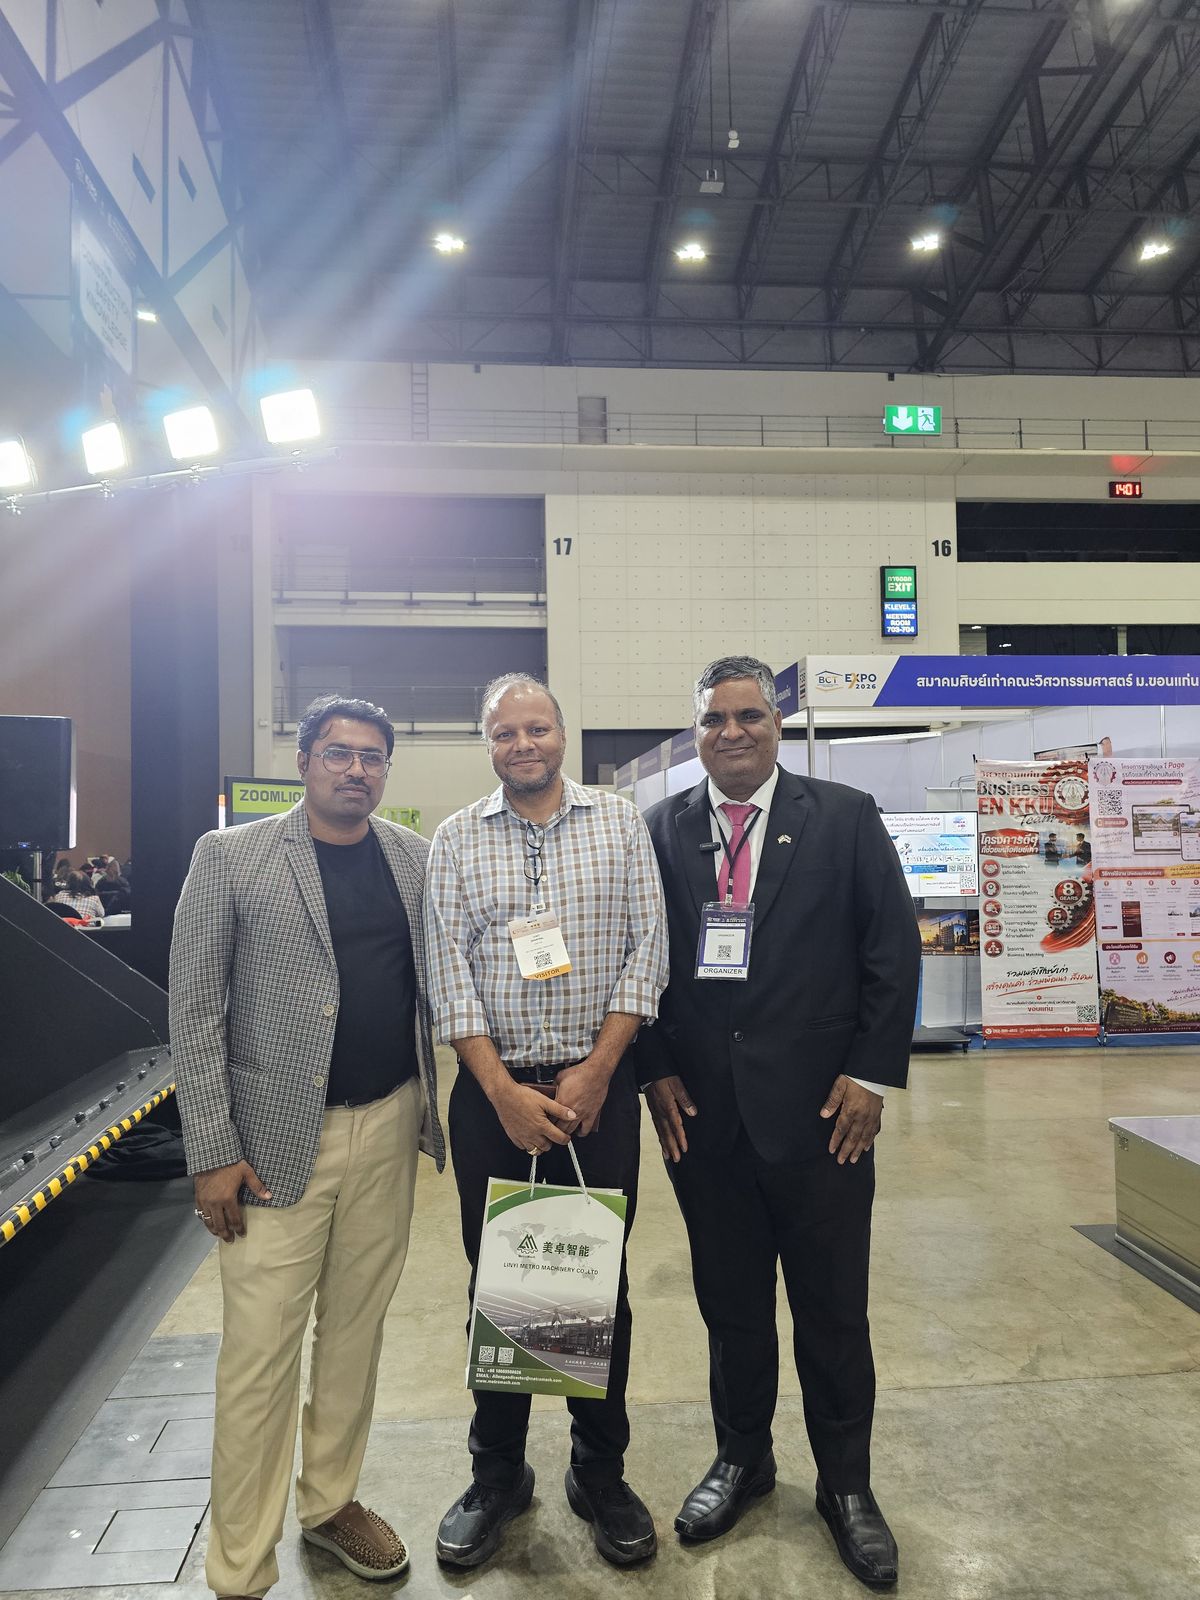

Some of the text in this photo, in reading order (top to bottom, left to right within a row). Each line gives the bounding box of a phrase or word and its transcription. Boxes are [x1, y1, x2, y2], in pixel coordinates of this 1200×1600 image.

[553, 537, 572, 555] 17
[932, 539, 952, 557] 16
[887, 582, 913, 592] EXIT
[818, 676, 837, 684] BCT
[844, 672, 877, 689] EXPO
[916, 673, 1199, 688] สมาคมศิษย์เก่าคณะวิศวกรรมศาสตร์ ม.ขอนแก่น
[1168, 761, 1185, 769] Page
[977, 780, 1049, 796] Business
[239, 789, 305, 803] ZOOMLIO
[978, 796, 1053, 816] EN KKU
[1016, 812, 1057, 827] Team
[1062, 882, 1075, 896] 8
[1053, 910, 1062, 920] 5
[535, 968, 560, 978] VISITOR
[703, 967, 743, 975] ORGANIZER
[542, 1241, 590, 1257] 美卓智能
[541, 1265, 575, 1273] MACHINERY
